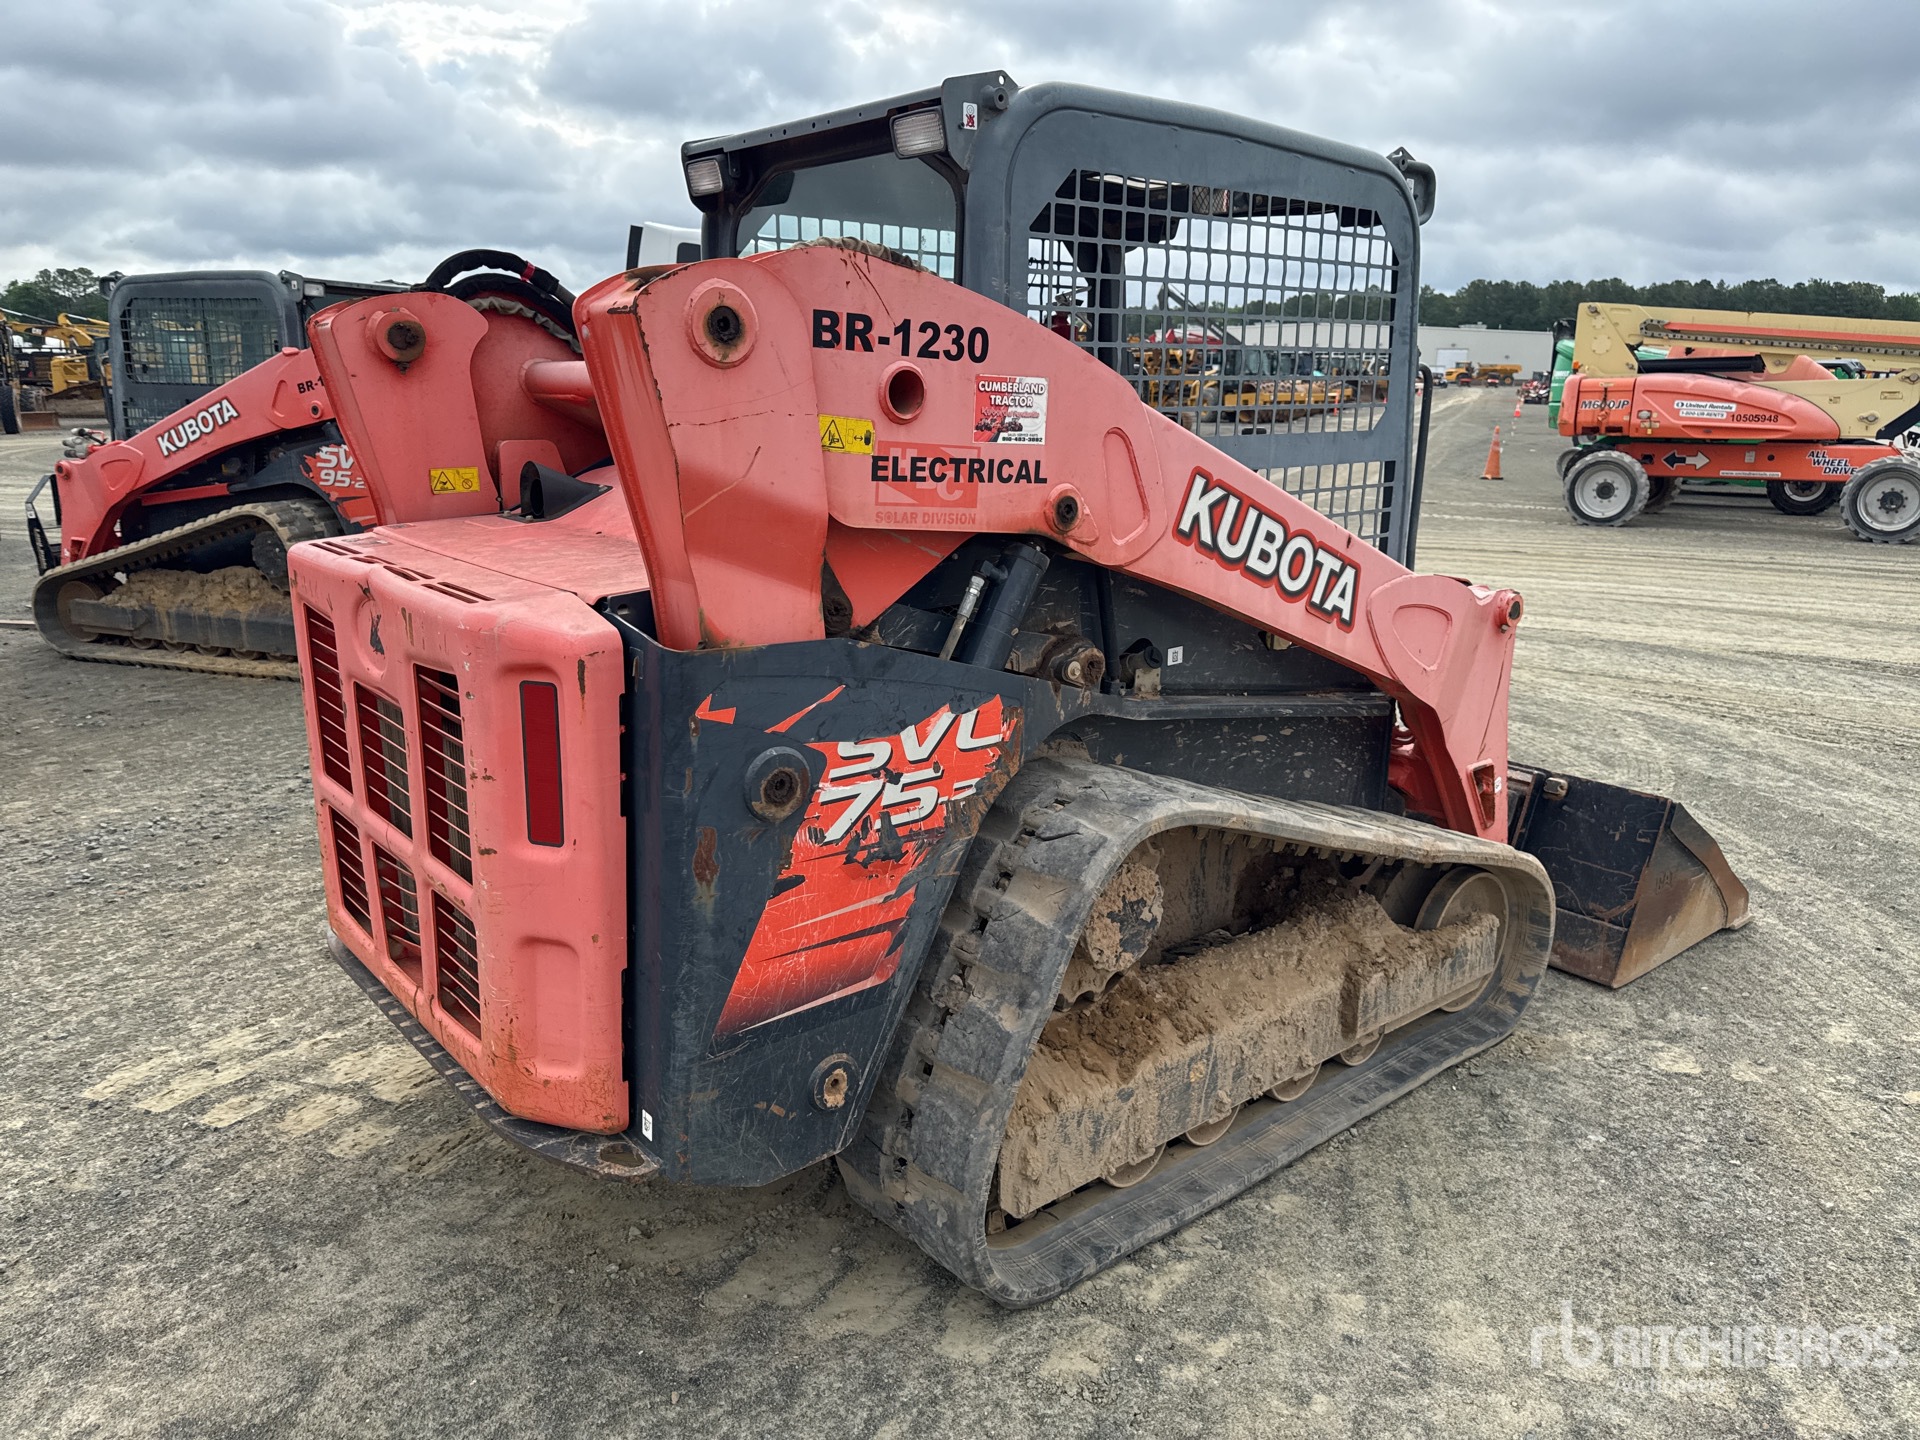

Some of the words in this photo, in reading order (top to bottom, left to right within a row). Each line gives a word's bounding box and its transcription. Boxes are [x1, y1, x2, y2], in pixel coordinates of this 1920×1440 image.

[812, 309, 989, 363] BR-1230
[978, 380, 1046, 395] CUMBERLAND
[989, 394, 1034, 407] TRACTOR
[1685, 402, 1707, 410] United
[1708, 402, 1733, 410] Rentals
[1730, 413, 1779, 423] 10505948
[157, 398, 239, 456] KUBOTA
[1808, 450, 1828, 459] ALL
[1812, 458, 1849, 467] WHEEL
[871, 455, 1048, 484] ELECTRICAL
[1823, 466, 1857, 475] DRIVE
[875, 511, 918, 523] SOLAR
[922, 511, 976, 525] DIVISION
[1177, 474, 1357, 624] KUBOTA
